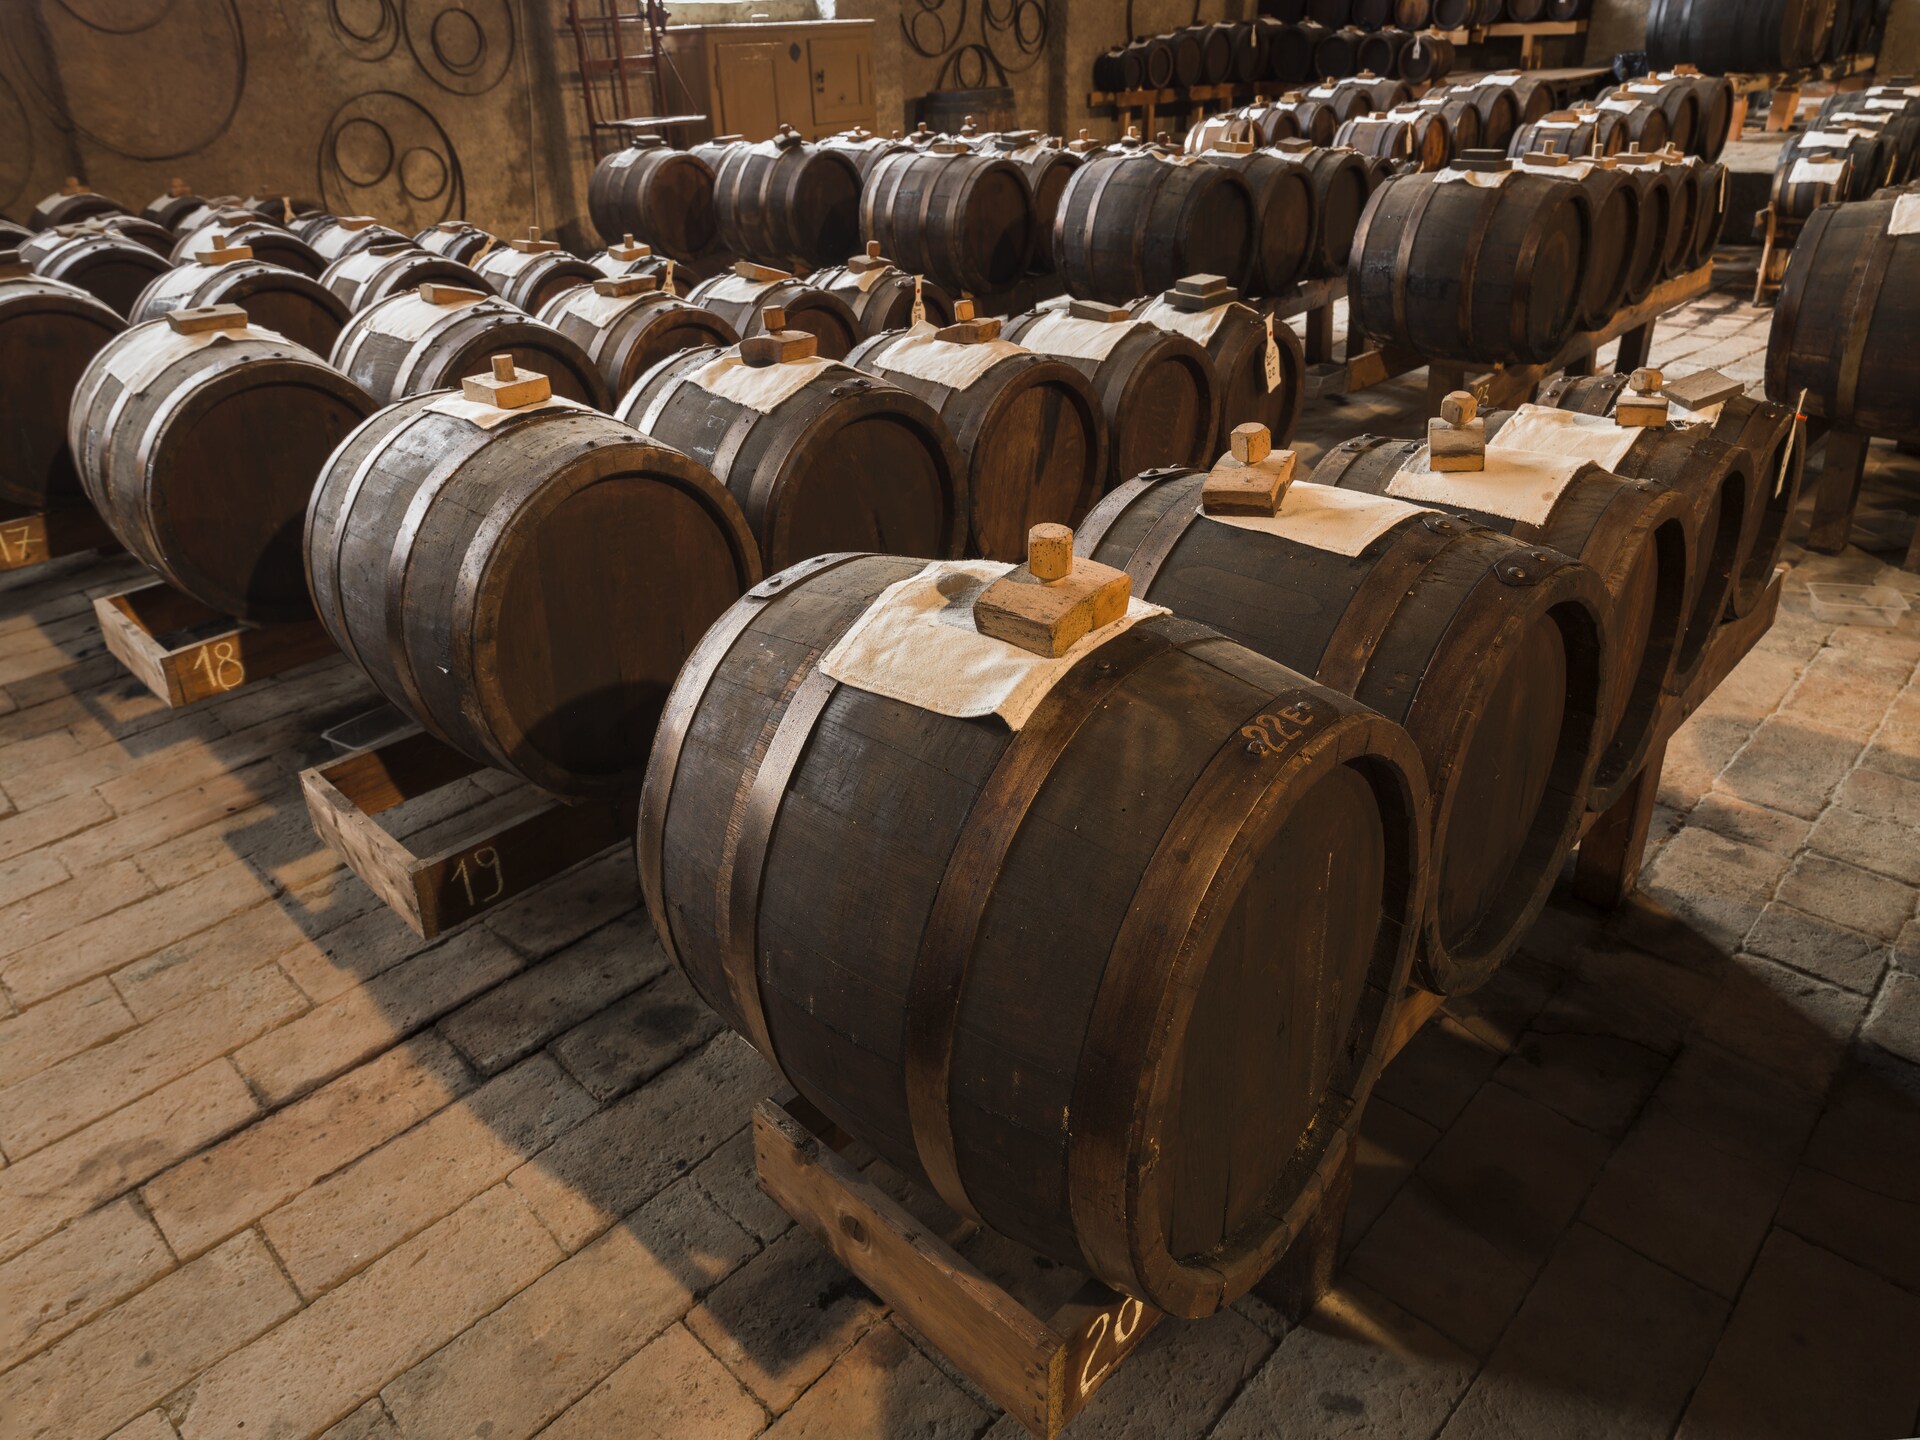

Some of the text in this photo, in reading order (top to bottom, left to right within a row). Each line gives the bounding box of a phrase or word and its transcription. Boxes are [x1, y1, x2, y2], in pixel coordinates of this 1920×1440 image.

[0, 526, 43, 562] 17
[193, 642, 245, 690] 18
[451, 846, 504, 906] 19
[1080, 1296, 1143, 1398] 20
